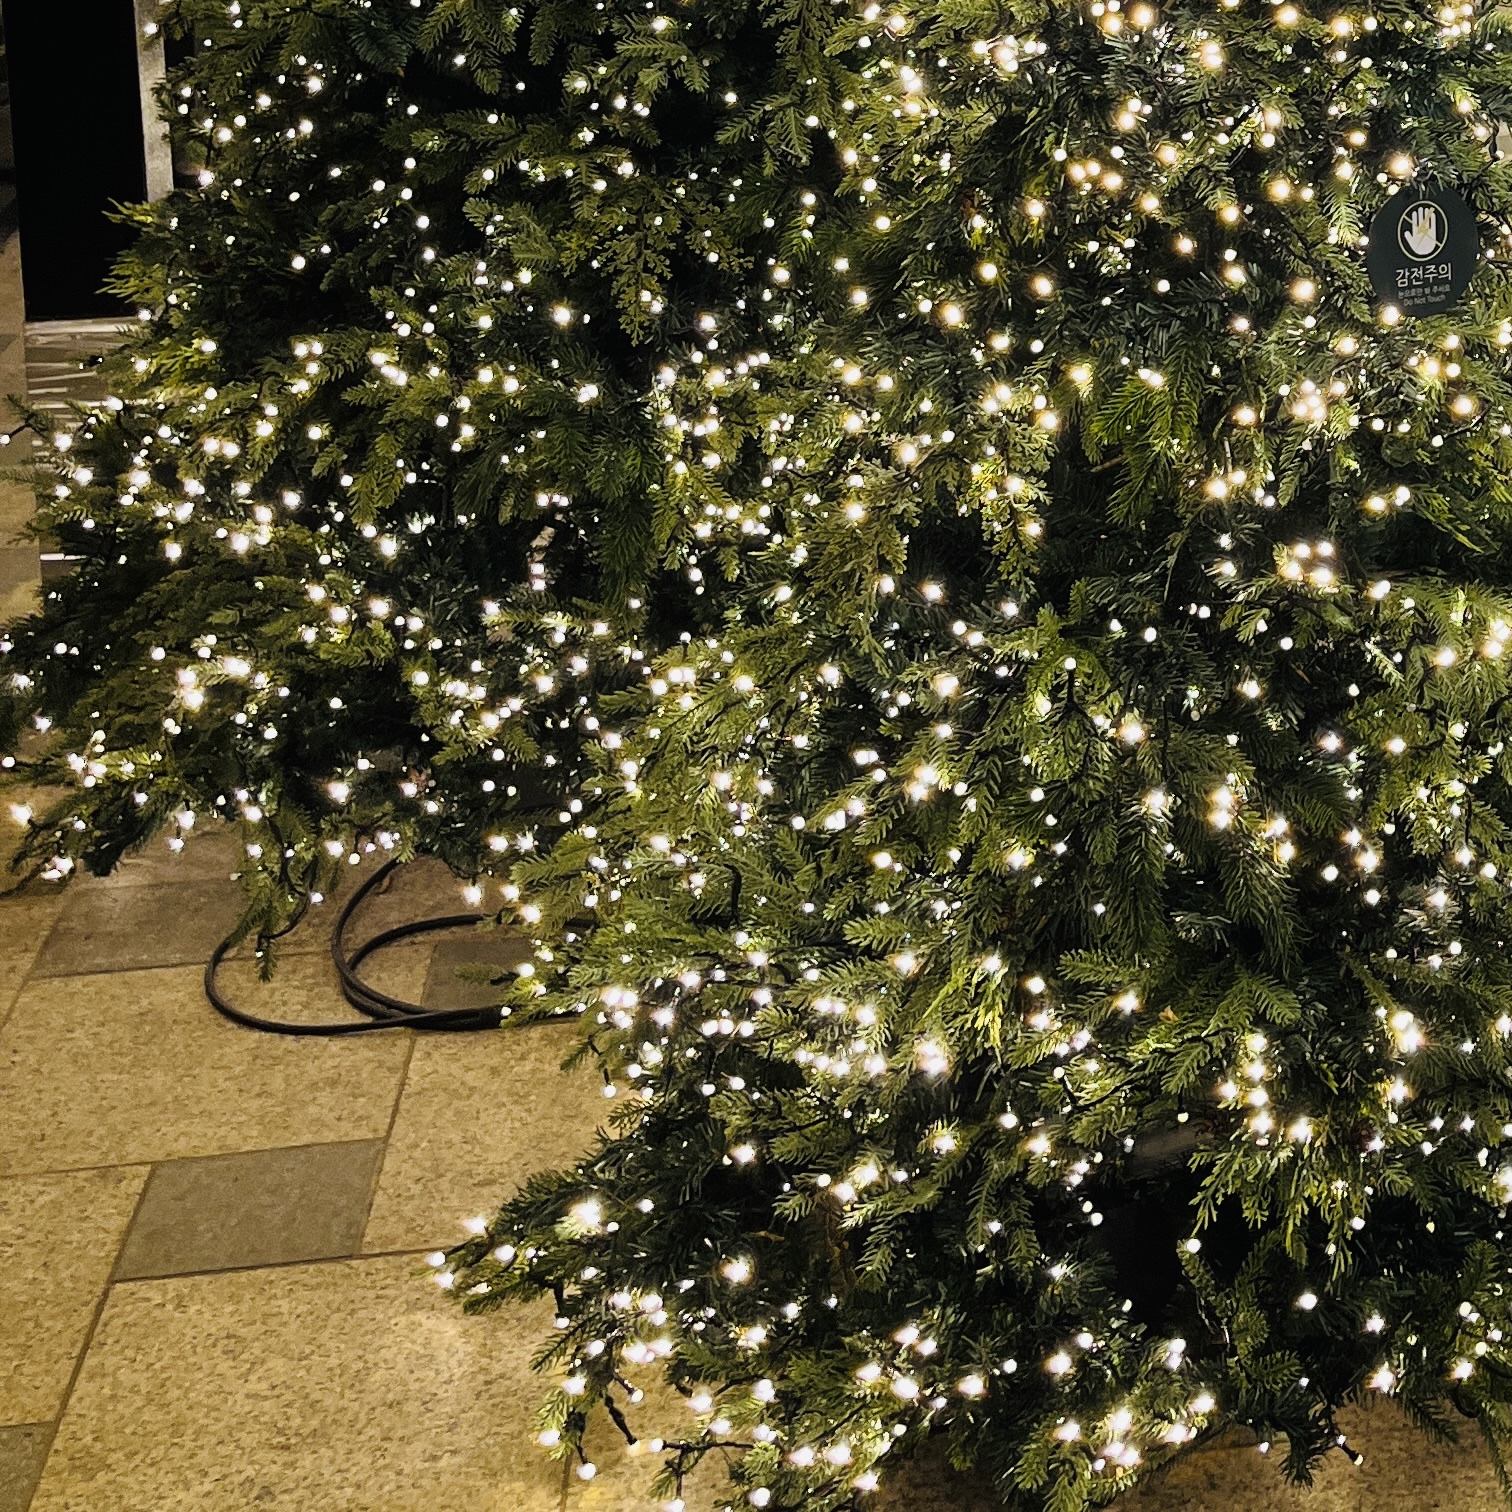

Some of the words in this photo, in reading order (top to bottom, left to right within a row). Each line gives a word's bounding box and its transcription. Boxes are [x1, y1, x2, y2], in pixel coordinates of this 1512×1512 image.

[1395, 262, 1452, 288] 감전주의
[1403, 298, 1413, 307] Do
[1427, 293, 1446, 303] Touch
